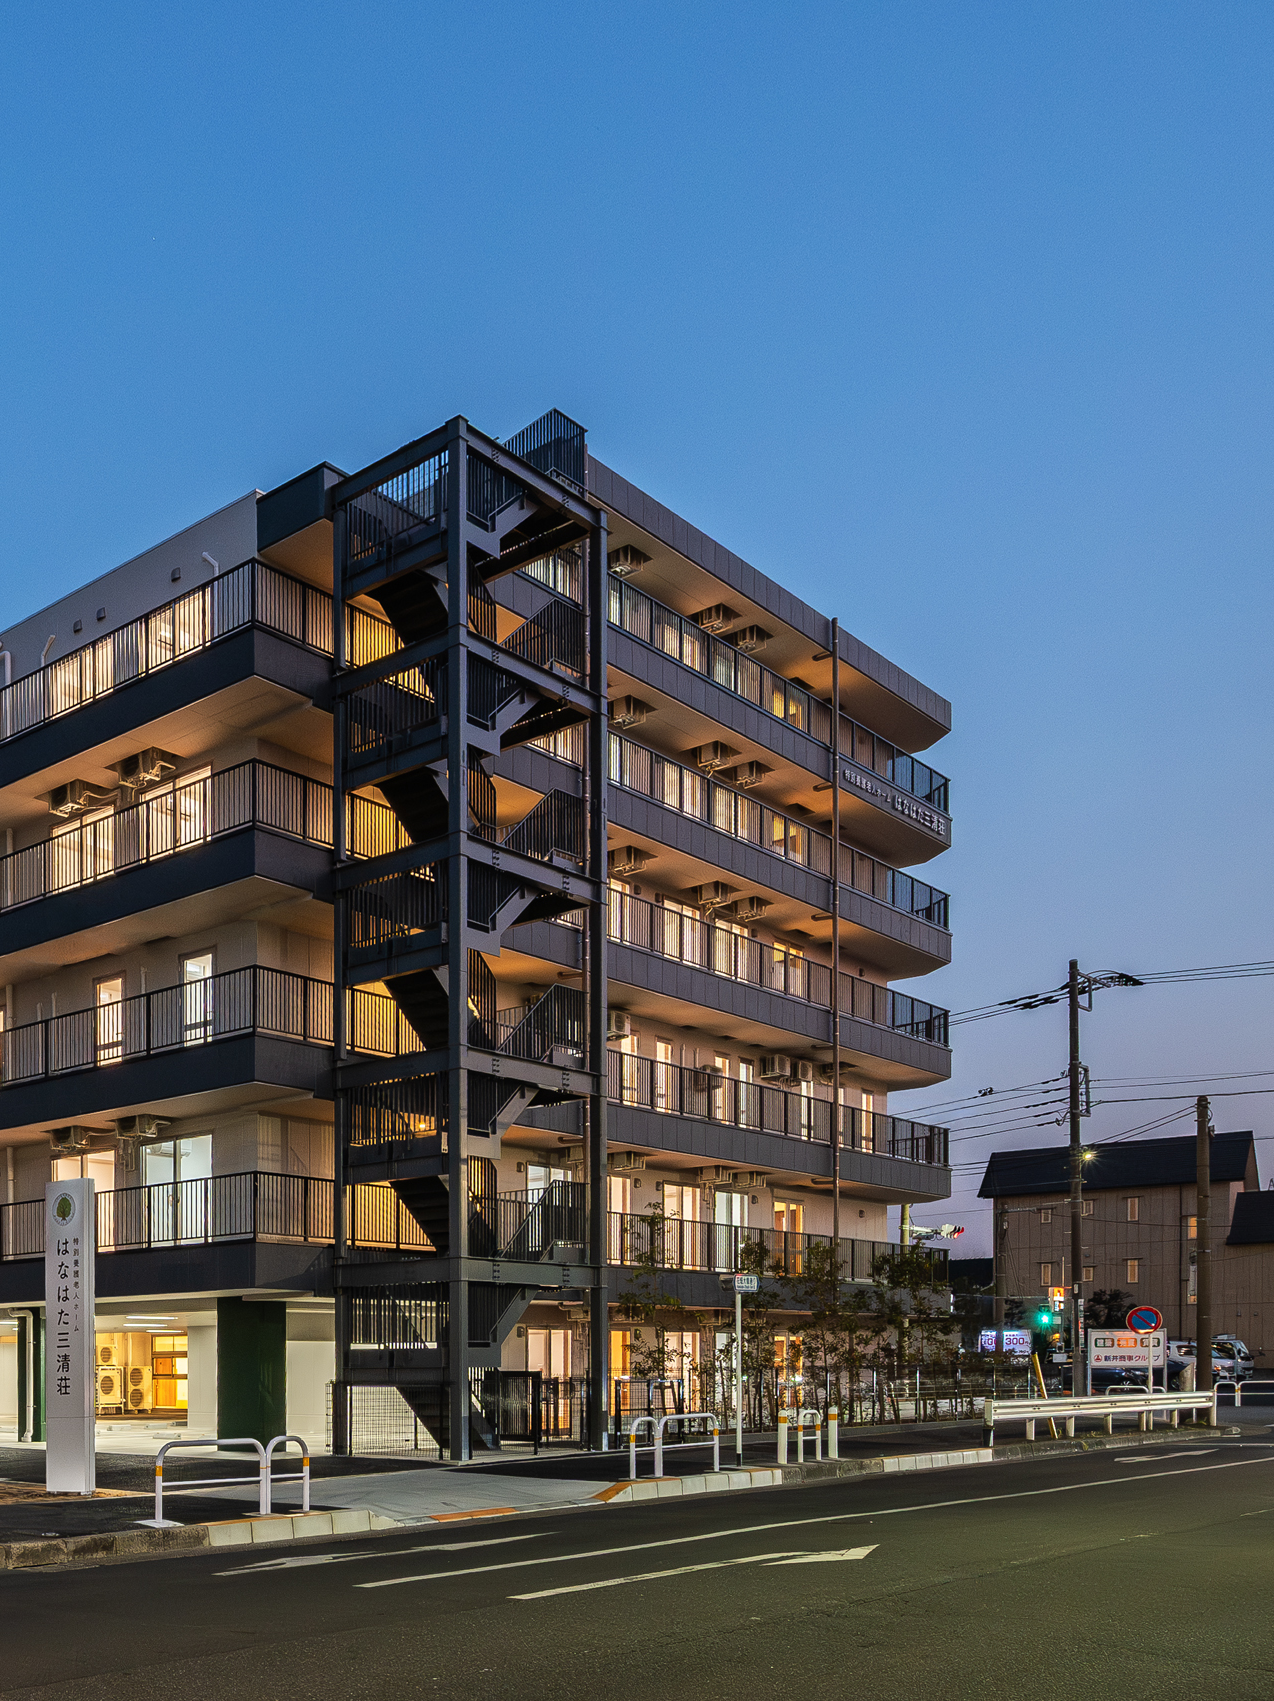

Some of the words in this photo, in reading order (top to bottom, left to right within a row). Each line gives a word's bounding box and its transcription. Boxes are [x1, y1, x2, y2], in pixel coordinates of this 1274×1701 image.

[844, 767, 891, 802] 特別養護老人ホーム
[894, 794, 946, 835] はなはた三清荘
[56, 1237, 71, 1396] はなはた三清荘
[72, 1237, 80, 1332] 特別養護老人ホーム
[1104, 1354, 1161, 1362] 新井商事グルプ
